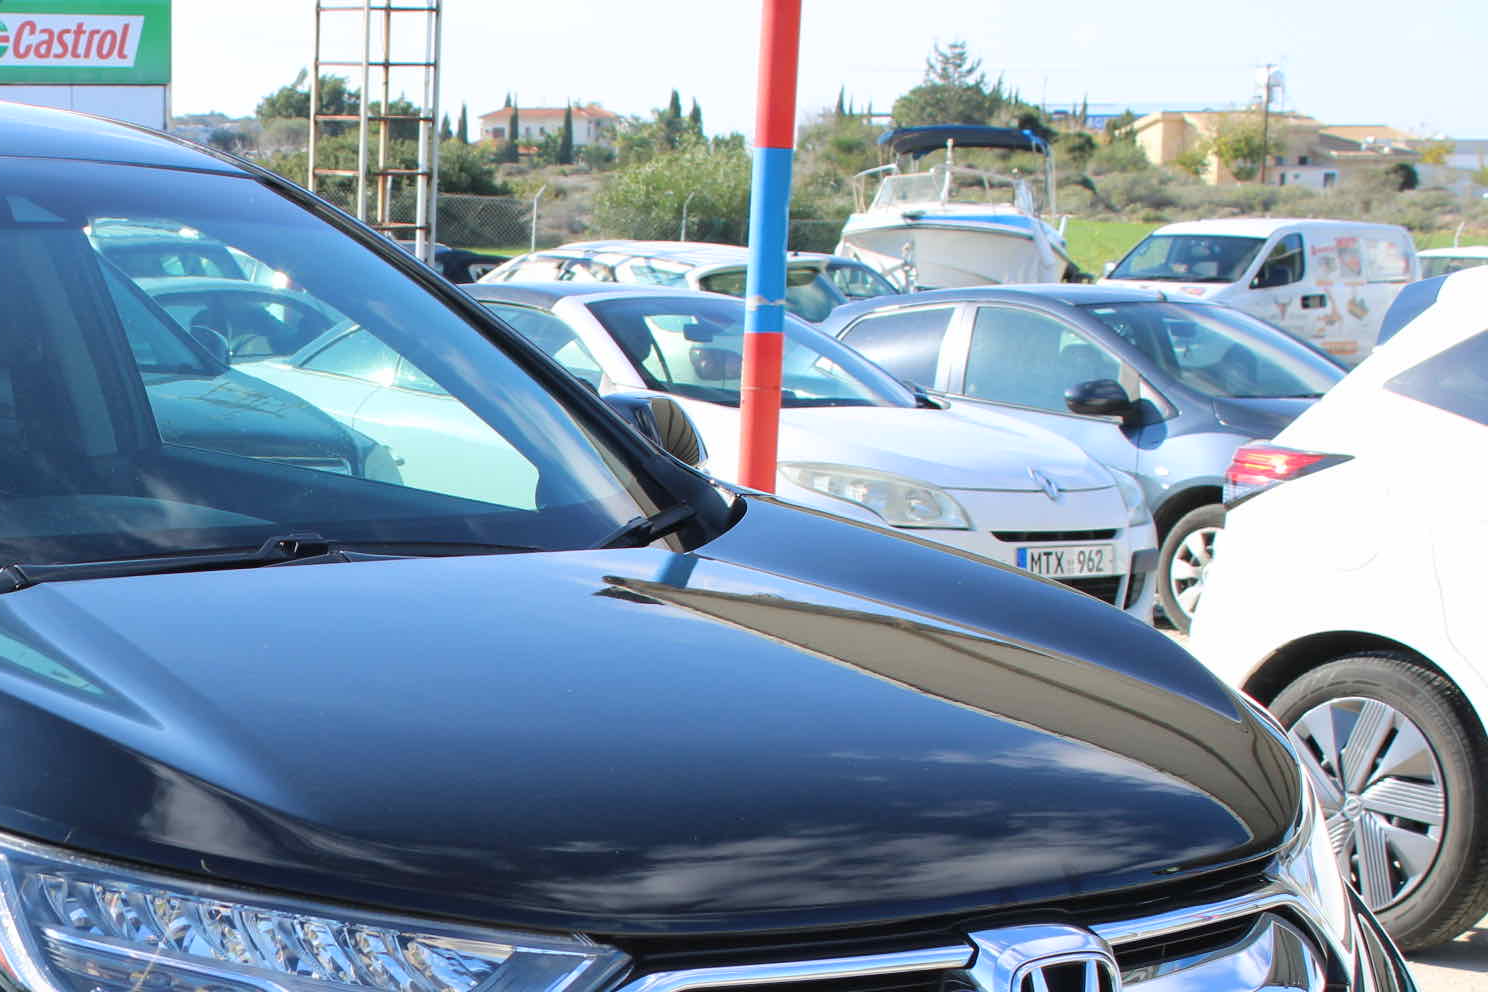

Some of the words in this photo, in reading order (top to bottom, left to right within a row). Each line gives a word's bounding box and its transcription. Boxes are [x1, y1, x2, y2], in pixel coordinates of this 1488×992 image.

[12, 20, 130, 60] Castrol
[1030, 550, 1065, 574] MTX
[1077, 549, 1104, 573] 962
